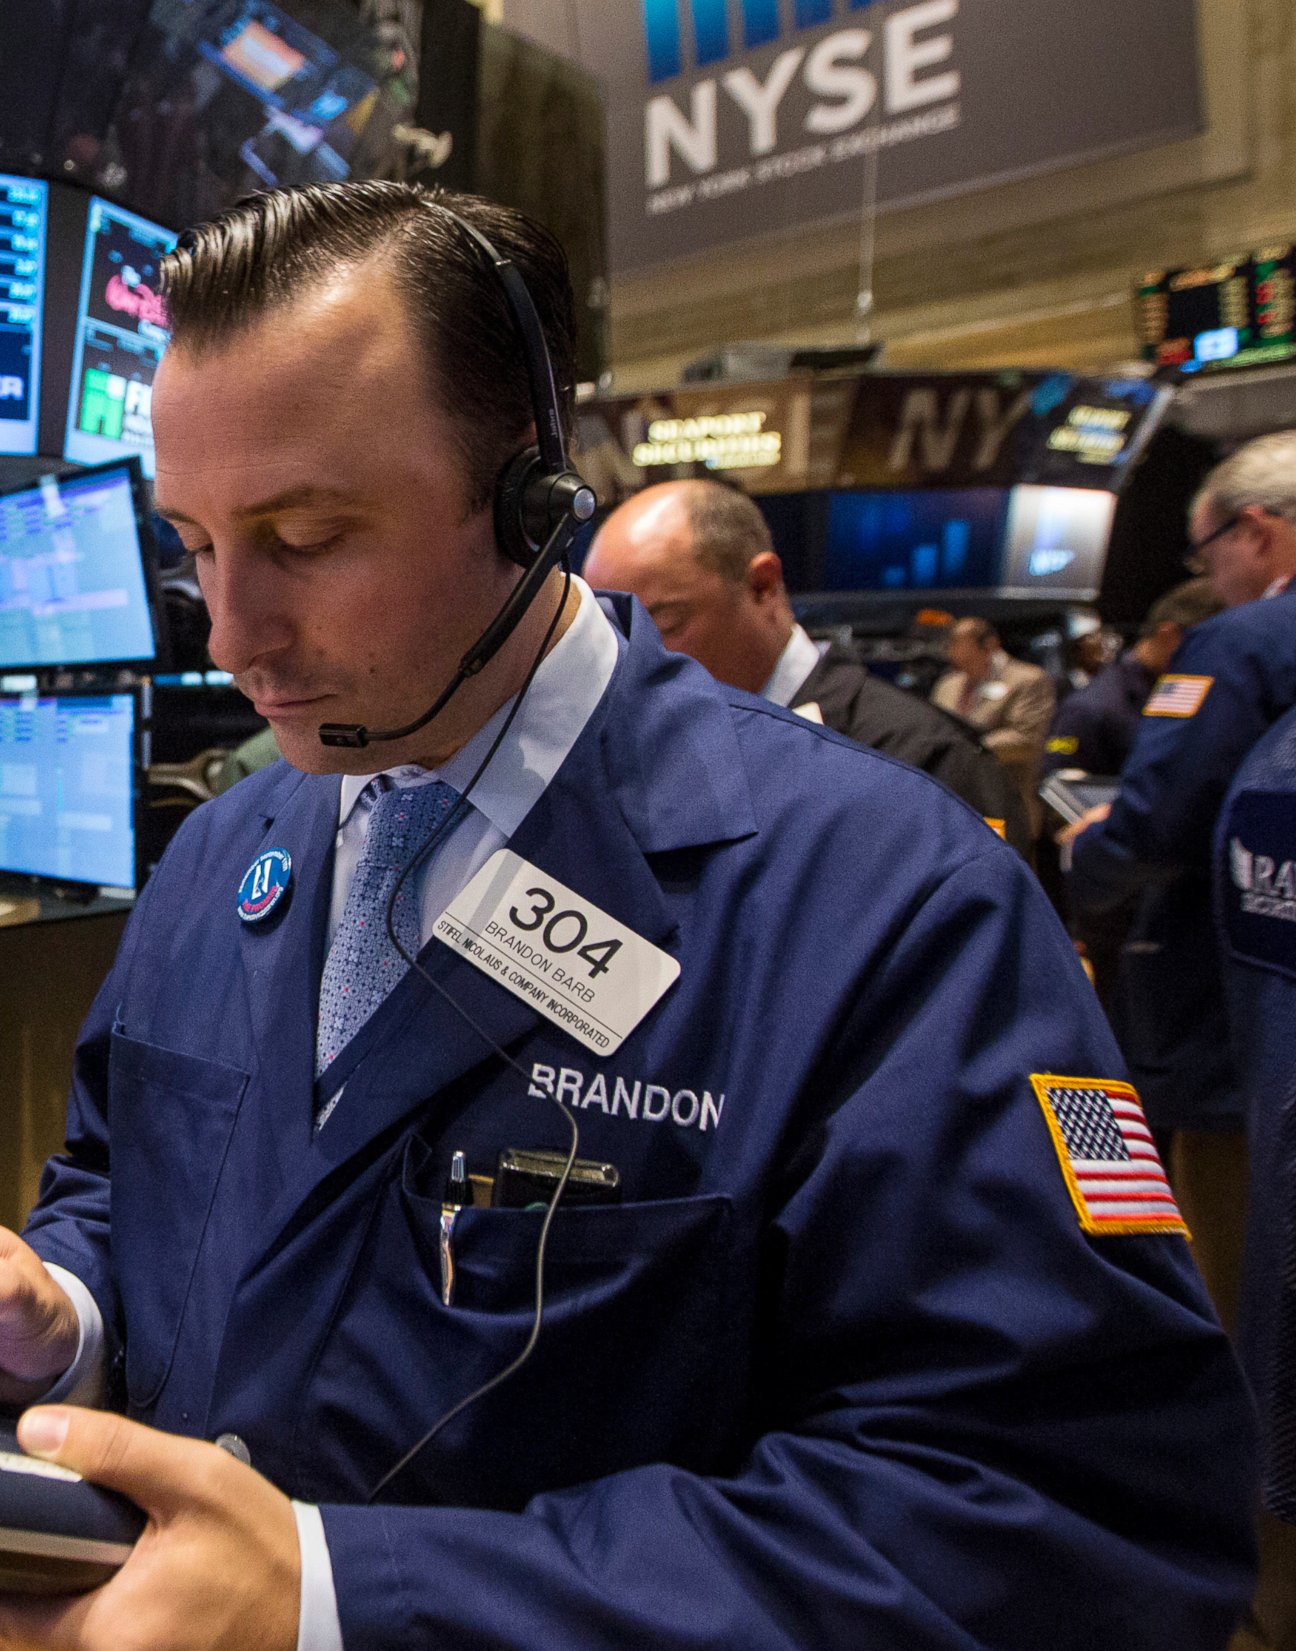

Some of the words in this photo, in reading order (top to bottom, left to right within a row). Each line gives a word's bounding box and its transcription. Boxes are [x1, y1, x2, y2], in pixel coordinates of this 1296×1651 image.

[645, 0, 962, 189] NYSE
[484, 919, 558, 972] BRANDON
[551, 968, 596, 1003] BARB
[508, 887, 623, 979] 304
[437, 920, 462, 945] STIFEL
[462, 936, 502, 971] NICOLAUS
[508, 967, 548, 1004] COMPANY
[546, 997, 611, 1049] INCORPORATED
[527, 1062, 725, 1132] BRANDON
